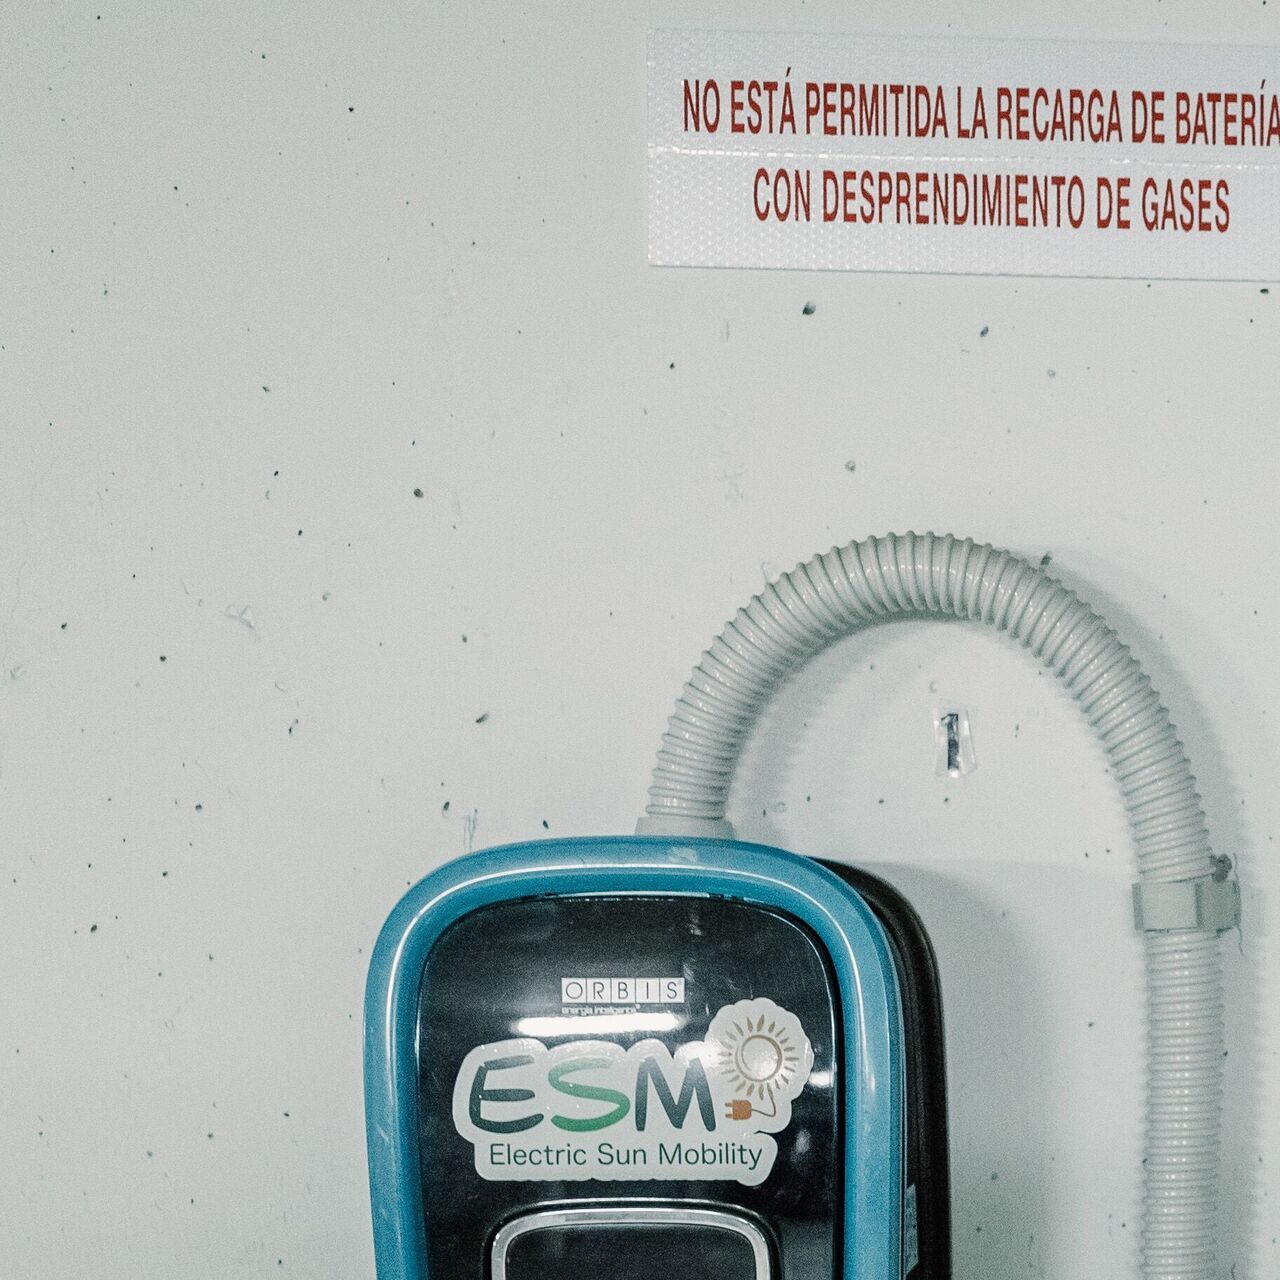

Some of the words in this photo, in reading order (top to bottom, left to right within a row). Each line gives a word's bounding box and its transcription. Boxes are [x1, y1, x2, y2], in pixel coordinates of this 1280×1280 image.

[683, 79, 721, 133] NO
[731, 66, 796, 134] ESTÁ
[806, 82, 949, 138] PERMITIDA
[957, 86, 989, 139] LA
[997, 87, 1123, 143] RECARGA
[1132, 91, 1165, 144] DE
[753, 168, 810, 222] CON
[823, 170, 1085, 229] DESPRENDIMIENTO
[1097, 177, 1130, 229] DE
[1142, 177, 1229, 233] GASES
[940, 713, 960, 770] 1
[565, 981, 678, 1000] ORBIS
[468, 1054, 716, 1133] ESM
[490, 1143, 586, 1165] Electric
[598, 1143, 646, 1165] Sun
[659, 1143, 762, 1170] Mobility
